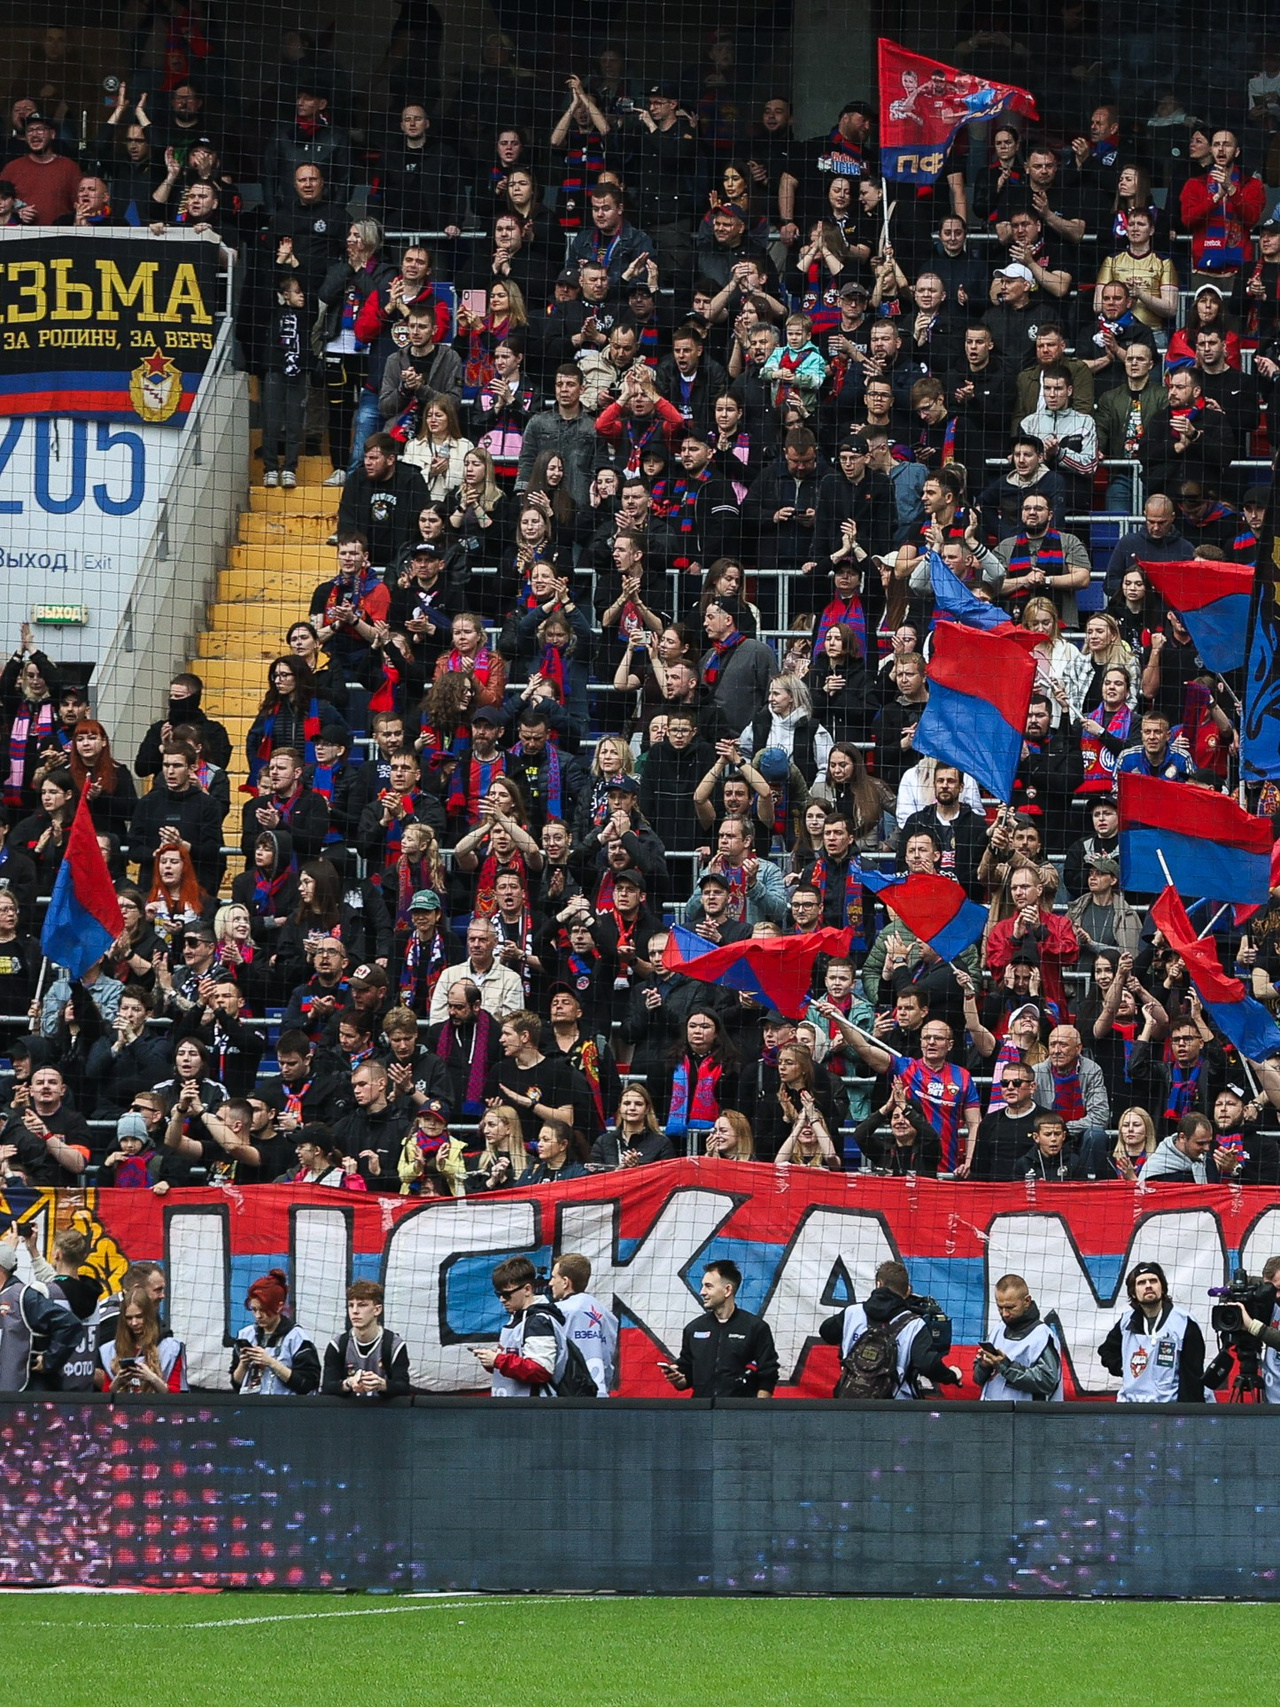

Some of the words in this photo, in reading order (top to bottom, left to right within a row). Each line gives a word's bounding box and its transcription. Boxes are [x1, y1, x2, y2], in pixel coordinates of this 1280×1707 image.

[0, 259, 213, 324] ЗЬМА
[4, 332, 30, 350] ЗА
[130, 330, 156, 347] ЗА
[165, 331, 213, 350] ВЕРУ
[84, 554, 112, 570] Exit
[37, 605, 82, 622] ВЫХОД
[164, 1186, 944, 1402] ЦСКА
[63, 1361, 93, 1377] ФОТО
